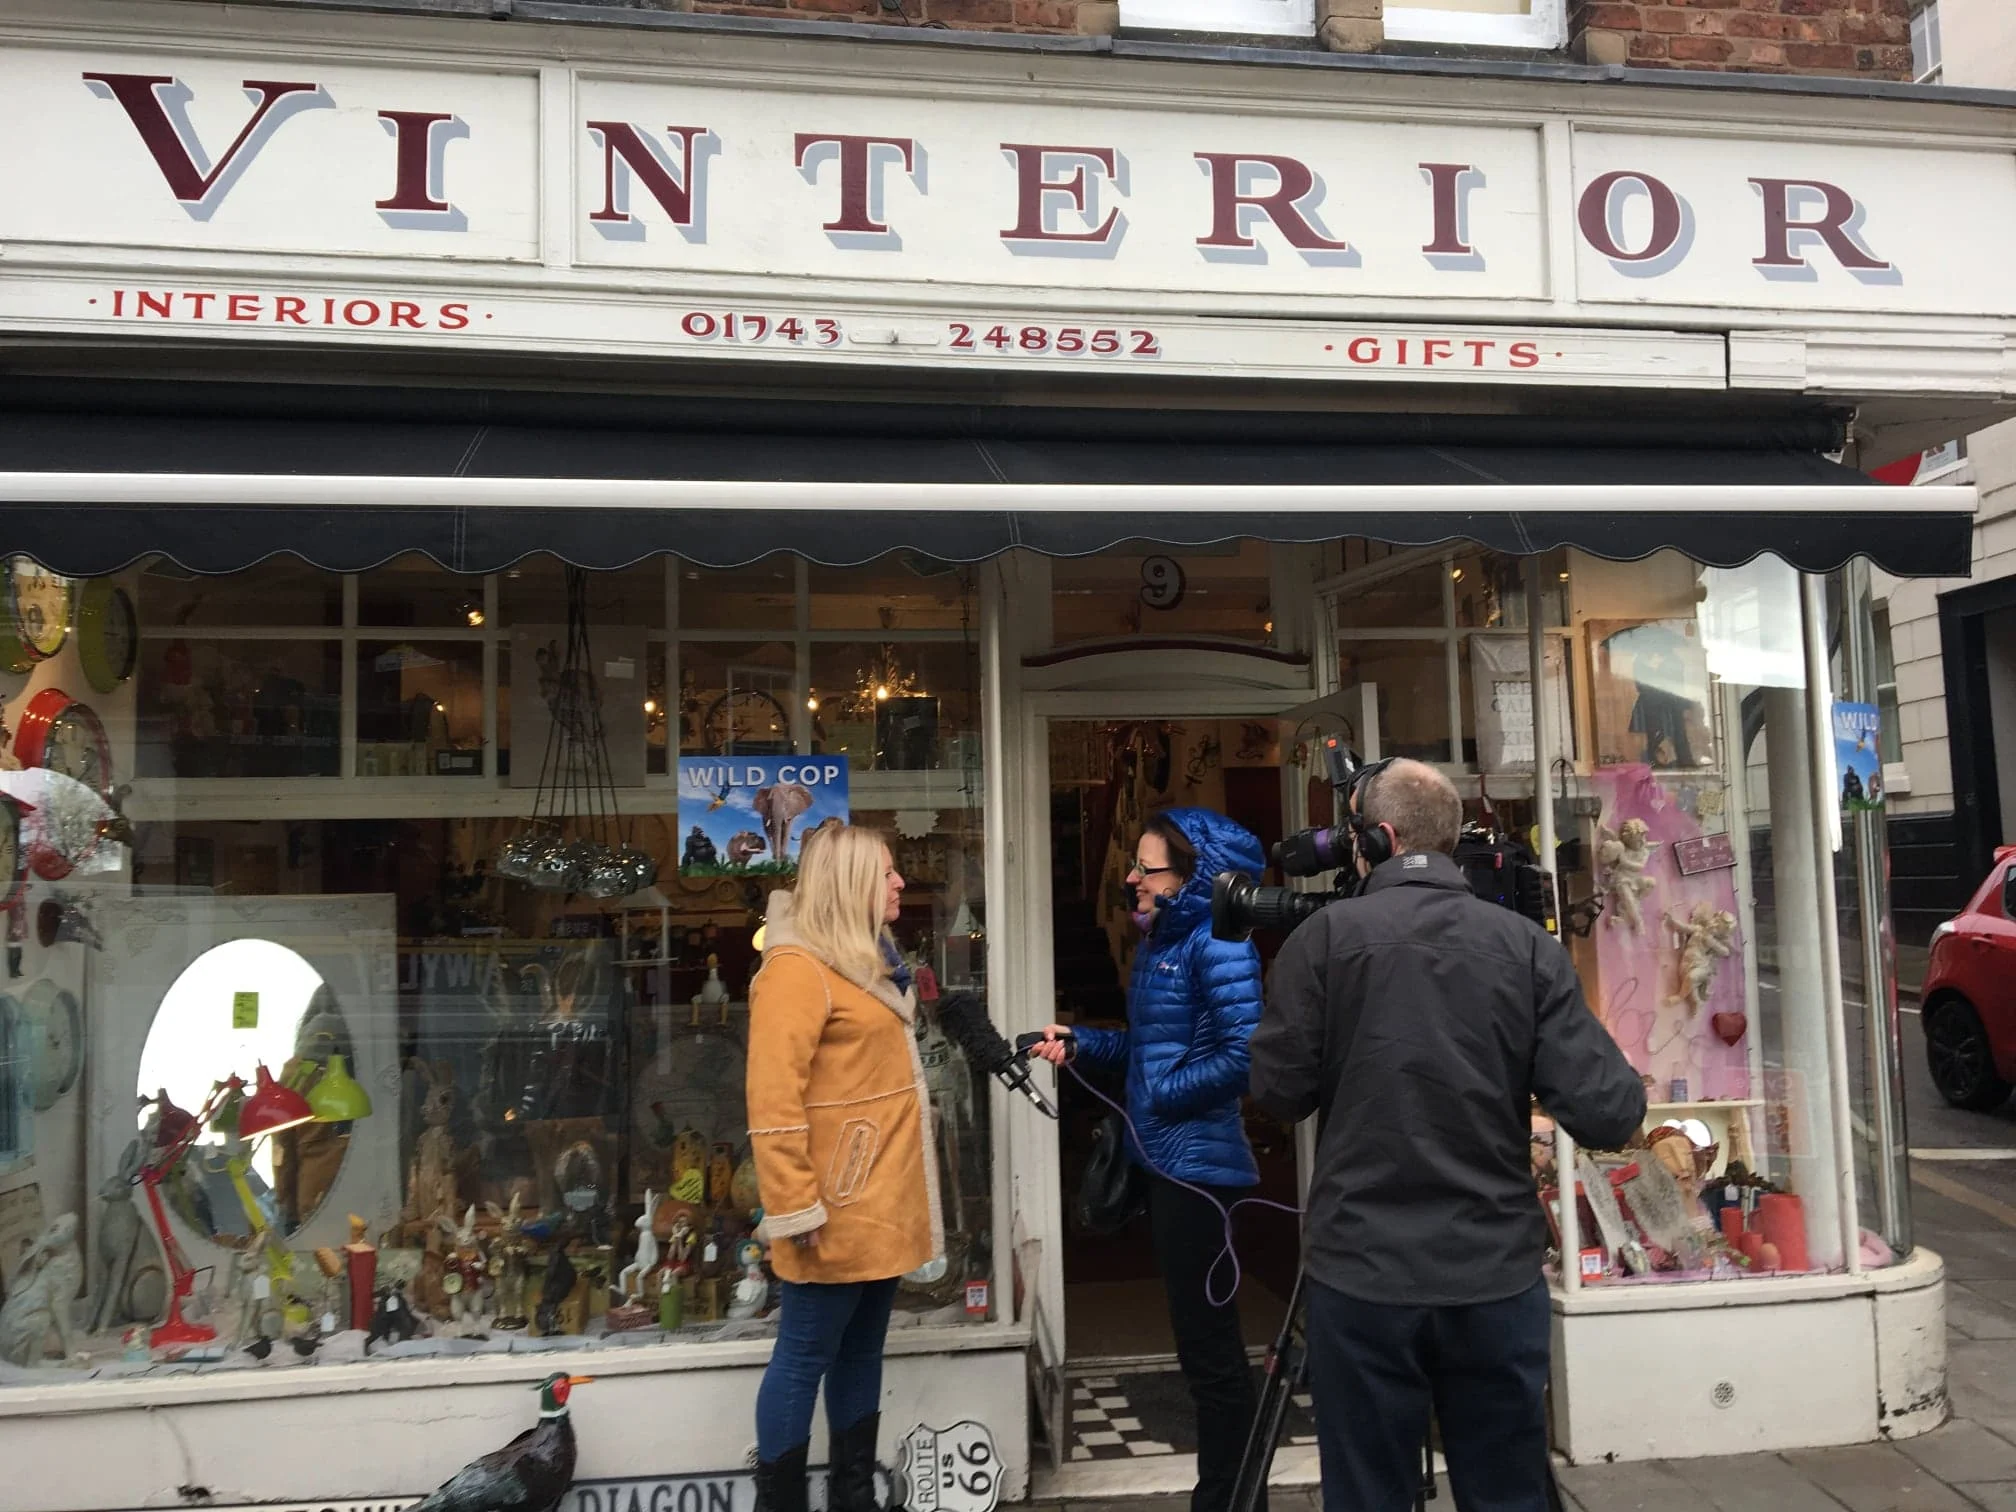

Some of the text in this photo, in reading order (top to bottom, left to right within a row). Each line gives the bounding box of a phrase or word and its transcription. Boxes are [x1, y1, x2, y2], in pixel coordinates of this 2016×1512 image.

[82, 72, 1901, 284] VINTERIOR
[112, 289, 471, 330] INTERIORS
[681, 312, 1162, 356] 01743 248552
[1347, 337, 1540, 368] GIFTS
[1141, 555, 1186, 611] 9
[1491, 680, 1531, 695] KEE
[1491, 698, 1531, 713] CAL
[688, 765, 840, 787] WILD COP
[916, 1439, 935, 1504] ROUTE
[942, 1453, 954, 1489] US
[957, 1441, 992, 1496] 66
